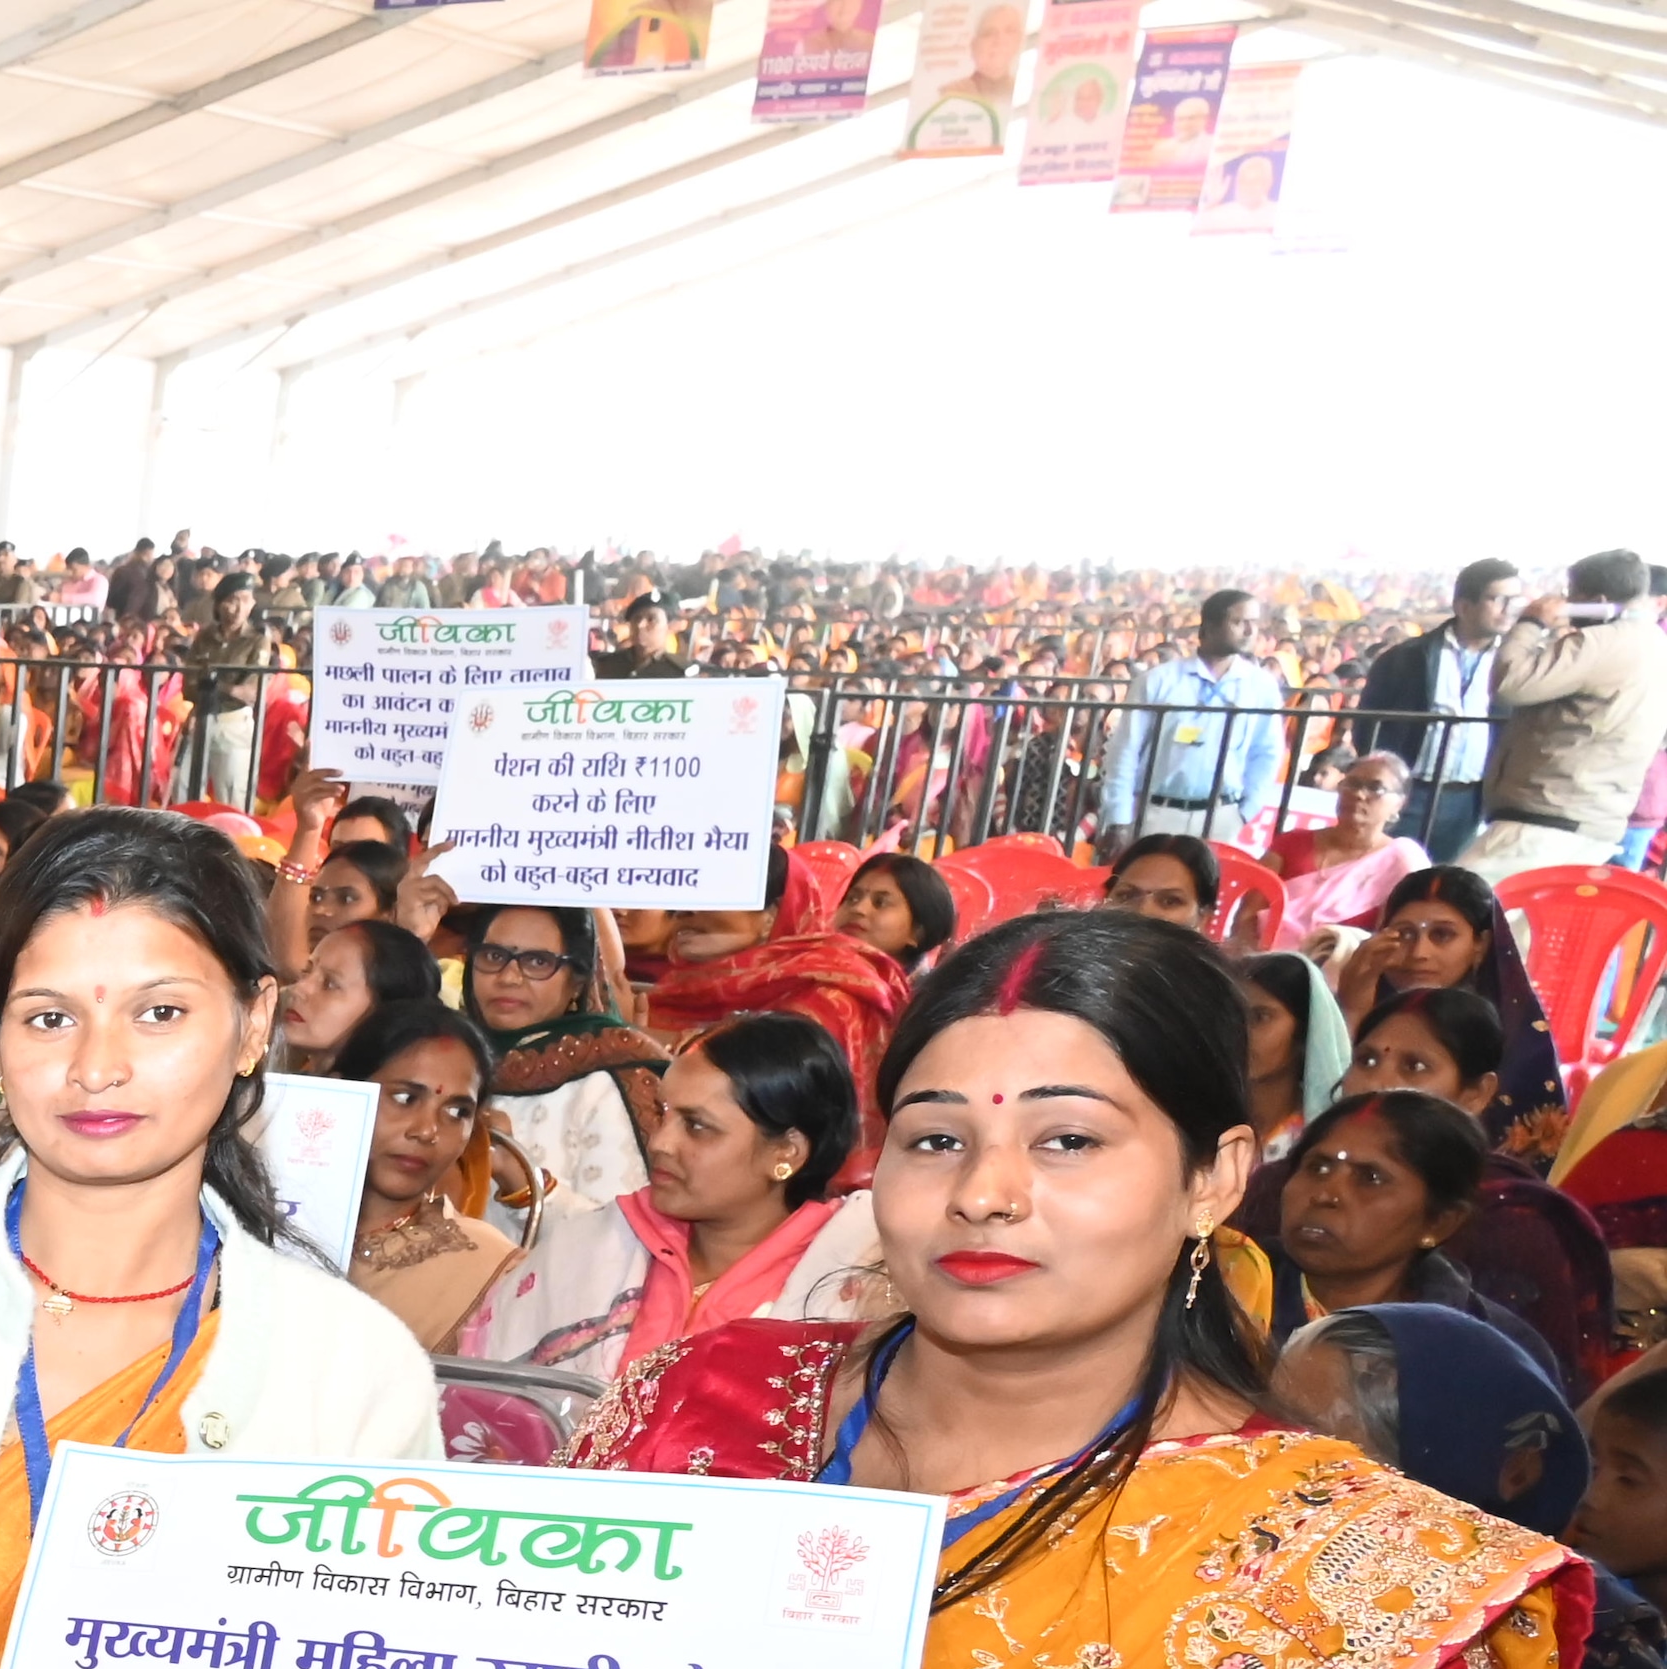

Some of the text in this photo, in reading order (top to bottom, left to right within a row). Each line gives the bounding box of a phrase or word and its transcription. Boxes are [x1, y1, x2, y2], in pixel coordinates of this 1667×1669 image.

[523, 692, 694, 725] जीविका
[547, 752, 575, 777] की
[582, 751, 627, 778] राशि
[635, 756, 701, 778] ₹1100
[532, 788, 657, 815] करने के लिए
[527, 824, 619, 855] मुख्यमंत्री
[626, 824, 695, 851] नीतीश
[704, 824, 750, 851] भैया
[480, 858, 507, 883] को
[616, 867, 700, 888] धन्यवाद
[235, 1477, 694, 1581] जीविका
[227, 1560, 669, 1622] ग्रामीण विकास विभाग, बिहार सरकार
